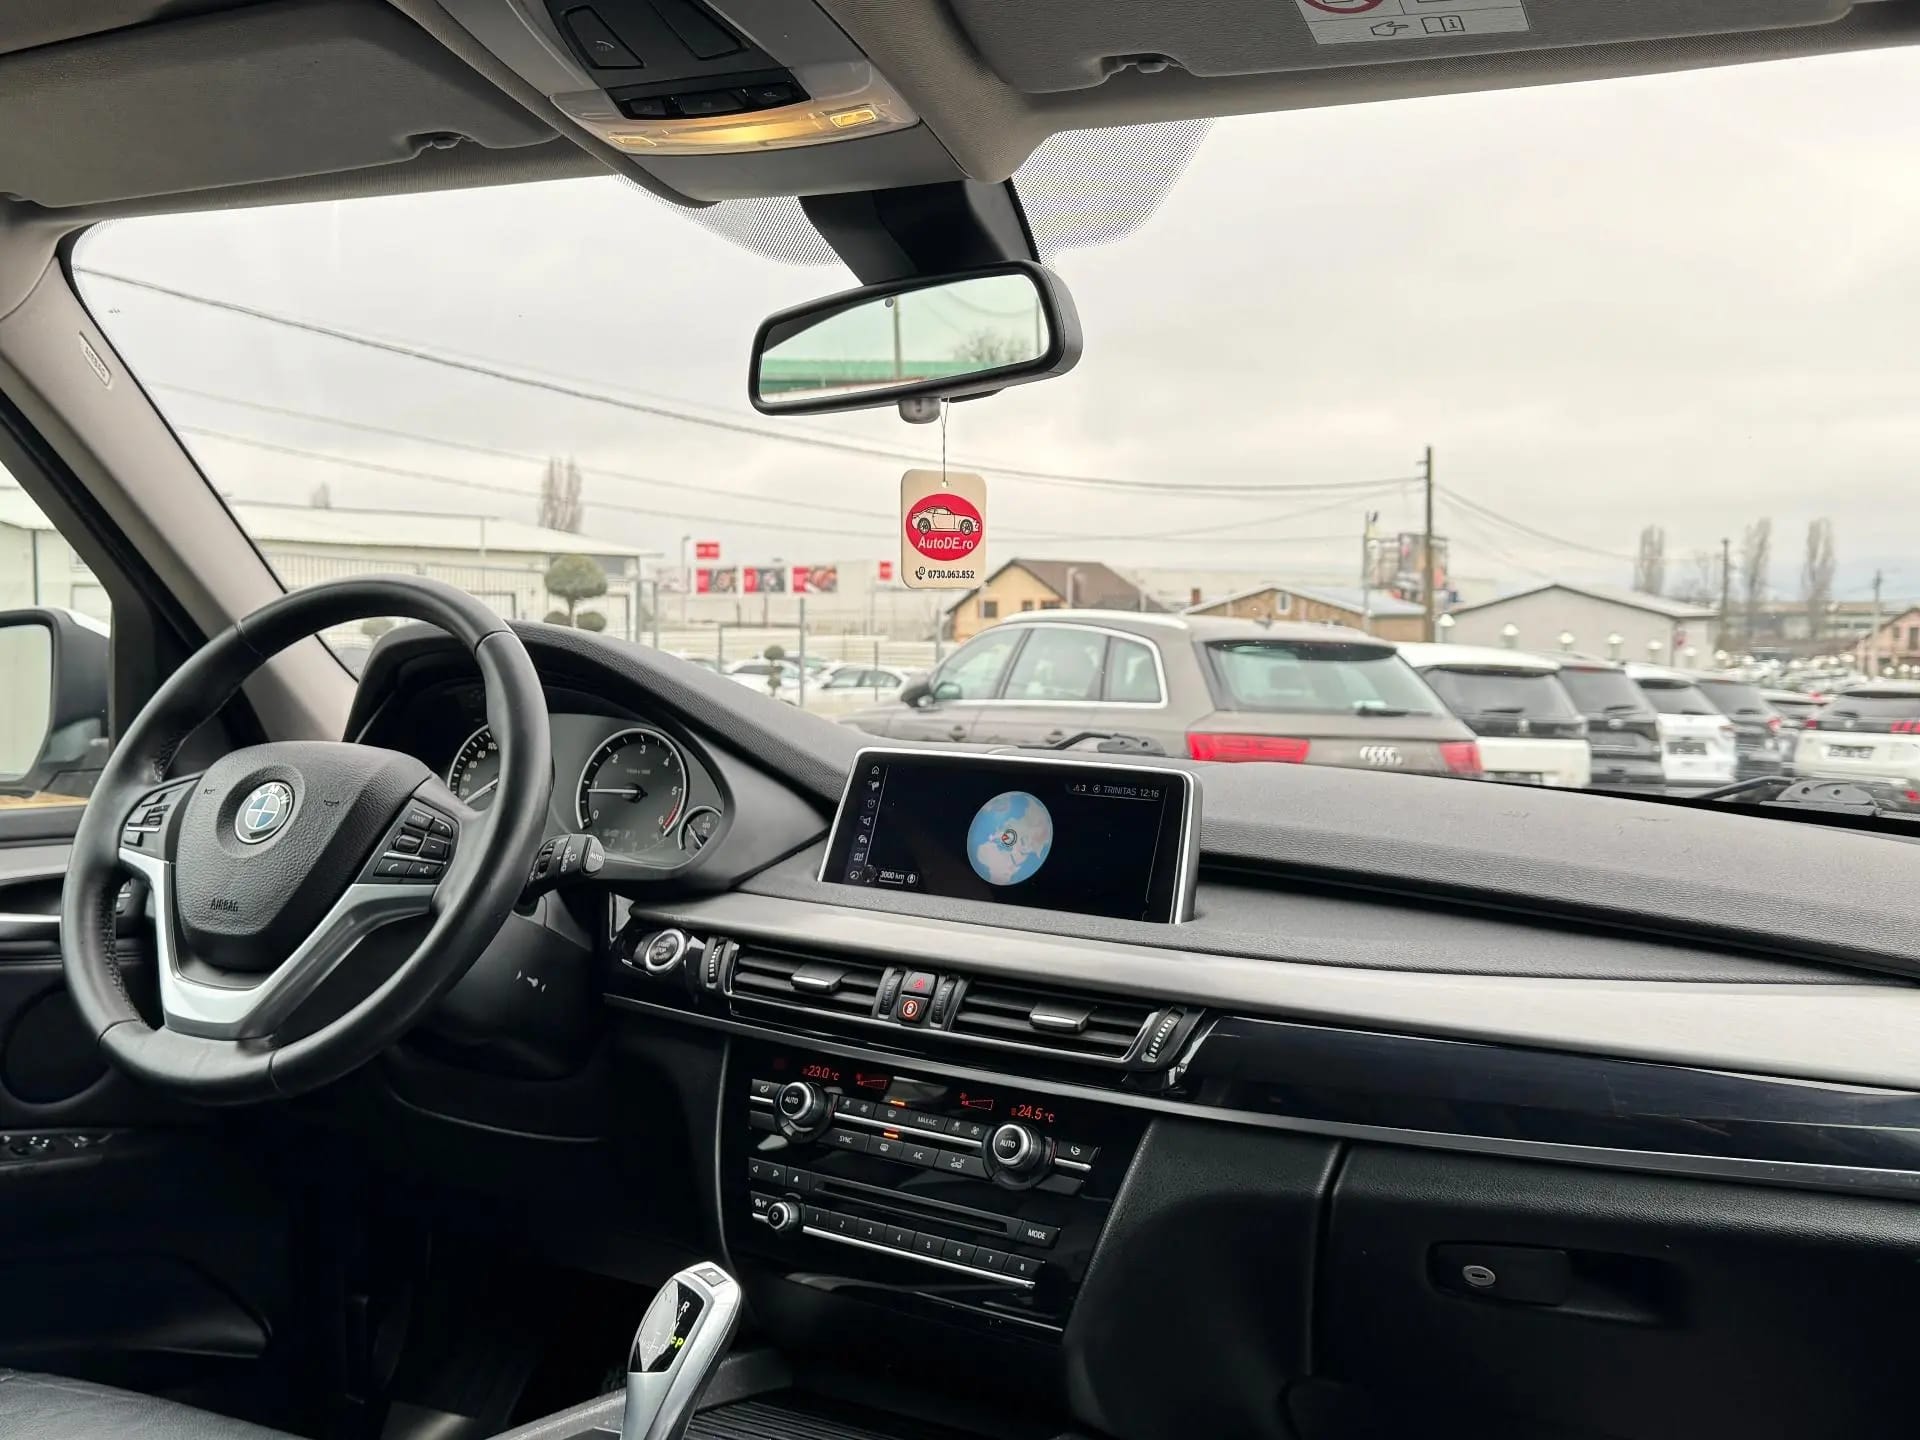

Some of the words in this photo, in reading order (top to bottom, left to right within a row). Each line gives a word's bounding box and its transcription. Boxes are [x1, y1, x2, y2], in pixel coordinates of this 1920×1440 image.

[918, 536, 974, 549] AutoDE.ro
[928, 570, 974, 579] 0730.063.852
[640, 745, 646, 755] 3
[612, 754, 619, 763] 2
[663, 758, 669, 767] 4
[252, 784, 290, 804] BMW
[671, 786, 678, 795] 5
[1081, 784, 1086, 792] 3
[1104, 785, 1137, 796] TRINITAS
[1140, 788, 1160, 798] 12:16
[593, 810, 599, 820] 0
[659, 815, 664, 825] 6
[591, 851, 603, 861] AUTO
[880, 870, 894, 879] 3000
[210, 897, 239, 911] AIRBAG
[807, 1065, 830, 1079] 23.0
[785, 1096, 799, 1105] AUTO
[1017, 1104, 1044, 1120] 24.5
[839, 1135, 853, 1144] SYNC
[1000, 1139, 1016, 1149] AUTO
[1027, 1229, 1046, 1240] MODE
[681, 1301, 690, 1313] R
[674, 1337, 684, 1349] P
